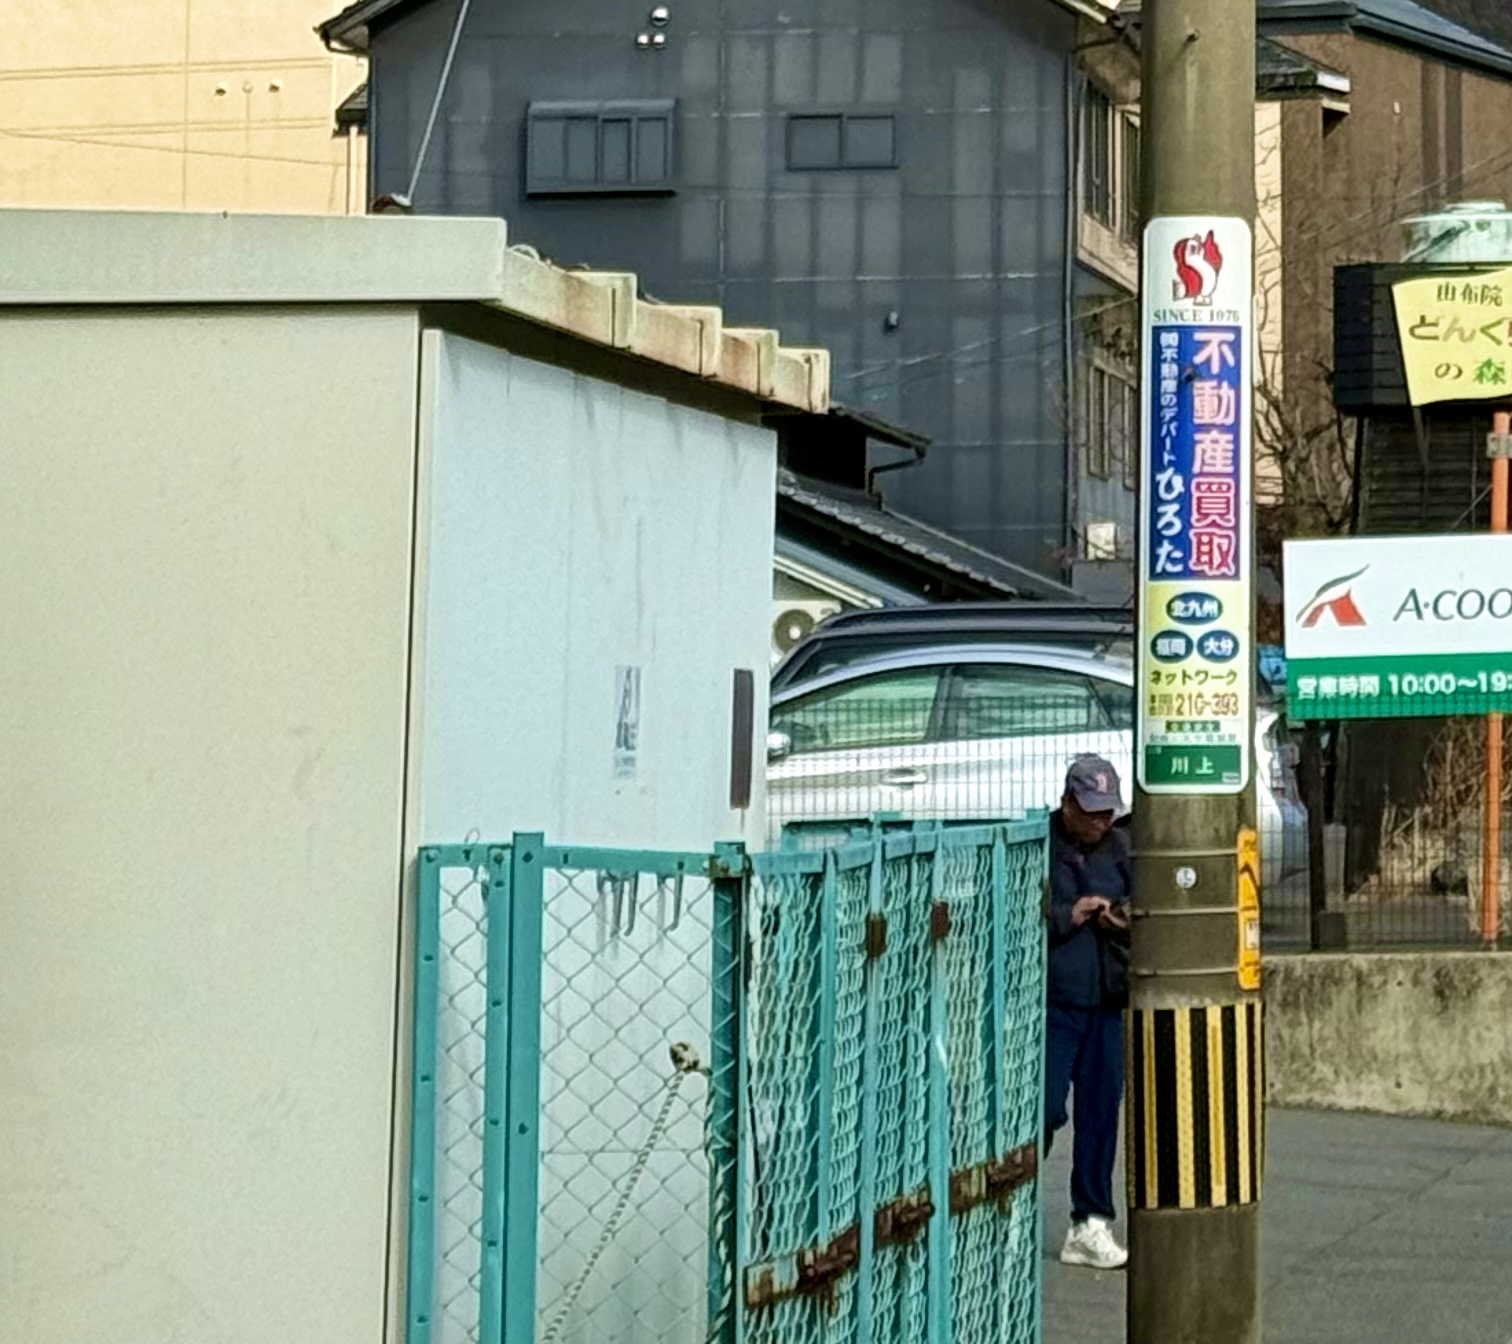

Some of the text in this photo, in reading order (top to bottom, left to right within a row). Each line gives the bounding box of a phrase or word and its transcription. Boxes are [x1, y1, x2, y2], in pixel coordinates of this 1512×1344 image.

[1153, 308, 1202, 322] SINCE
[1188, 332, 1236, 576] 不動産買取
[1170, 598, 1219, 618] 北九州
[1203, 637, 1235, 657] 大分
[1151, 669, 1237, 686] ネットワーク
[1297, 674, 1380, 700] 営業時間
[1170, 755, 1215, 775] 川上
